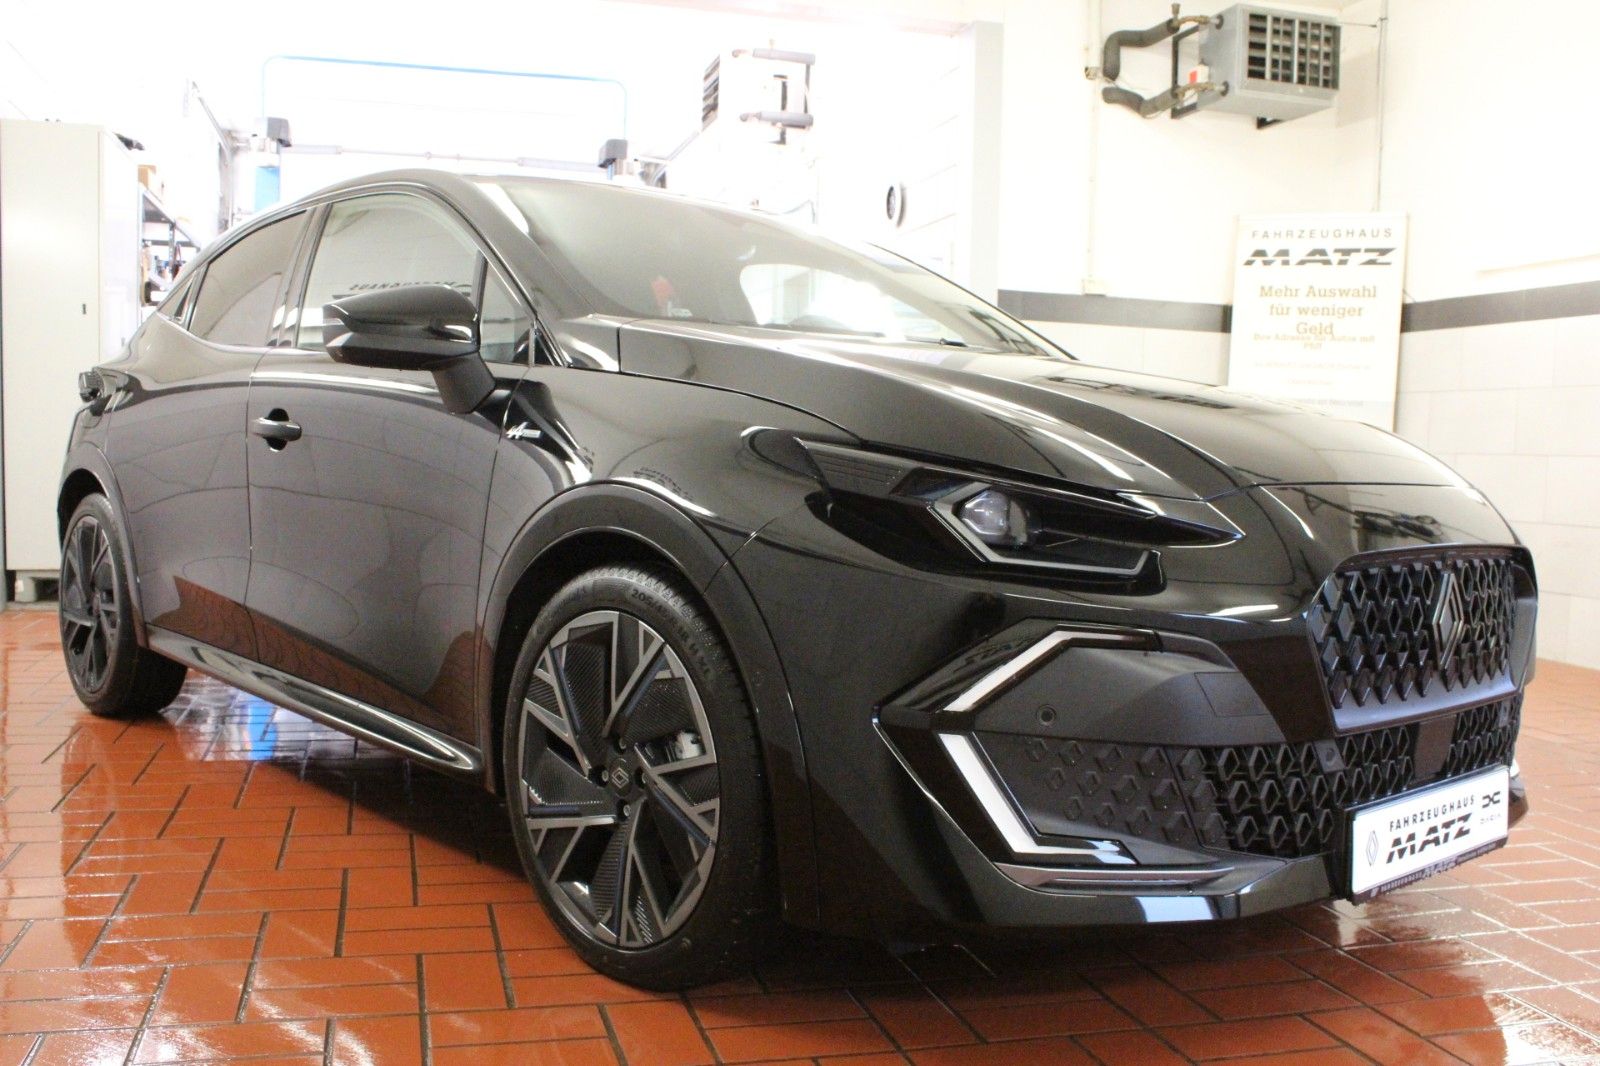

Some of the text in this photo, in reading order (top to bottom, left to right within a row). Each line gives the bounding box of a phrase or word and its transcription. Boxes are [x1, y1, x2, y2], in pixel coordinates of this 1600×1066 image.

[1251, 228, 1393, 239] FAHRZEUGHAUS
[1243, 248, 1397, 266] MATZ
[1259, 285, 1377, 298] Mehr Auswahl
[1269, 304, 1363, 319] für weniger
[1296, 322, 1334, 336] Geld
[1389, 794, 1475, 832] FAHRZEUGHAUS
[1386, 812, 1472, 864] MATZ
